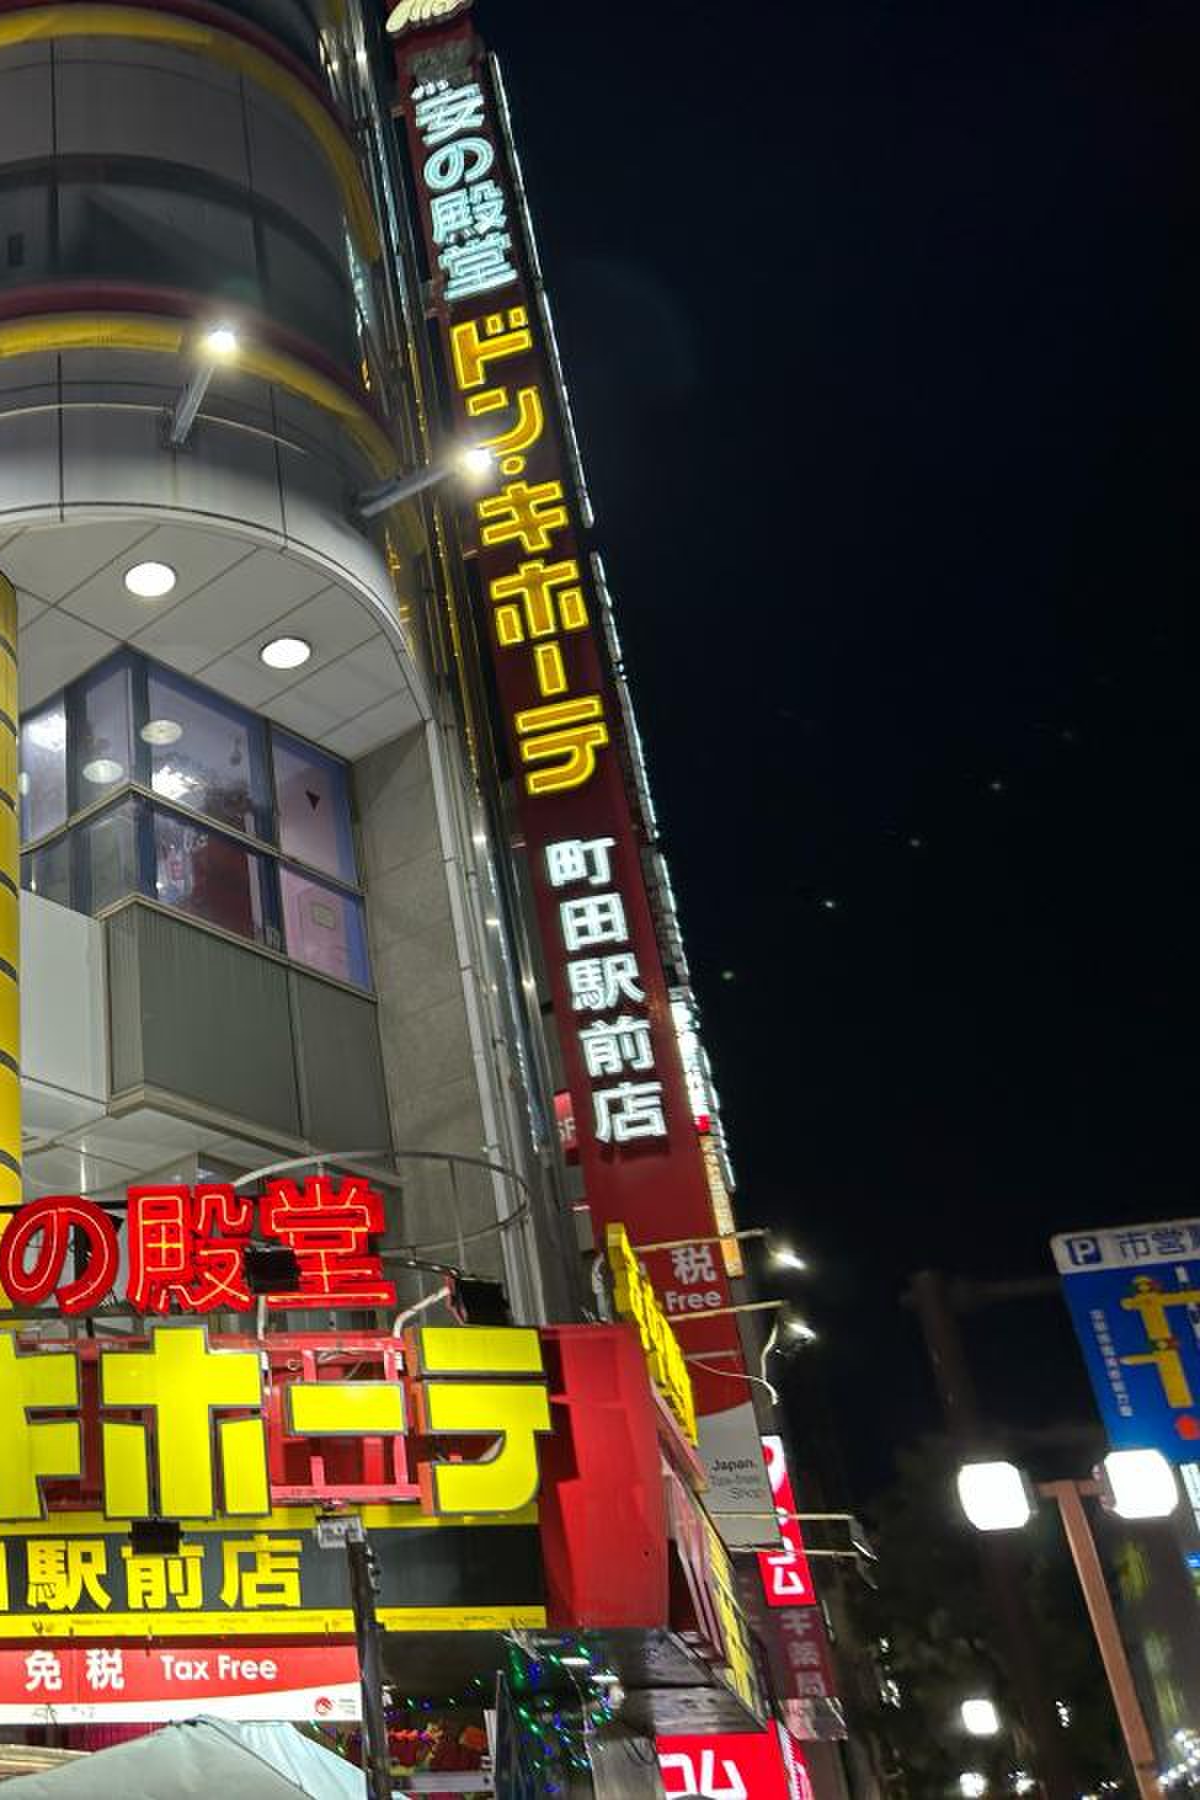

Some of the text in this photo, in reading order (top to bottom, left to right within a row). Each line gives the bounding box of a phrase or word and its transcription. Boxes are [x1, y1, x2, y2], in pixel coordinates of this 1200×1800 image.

[411, 42, 519, 299] 安の殿堂
[544, 836, 668, 1143] 町田駅前店
[664, 1291, 721, 1312] Free
[767, 1507, 805, 1595] コム
[160, 1655, 209, 1681] Tax
[217, 1655, 278, 1680] Free
